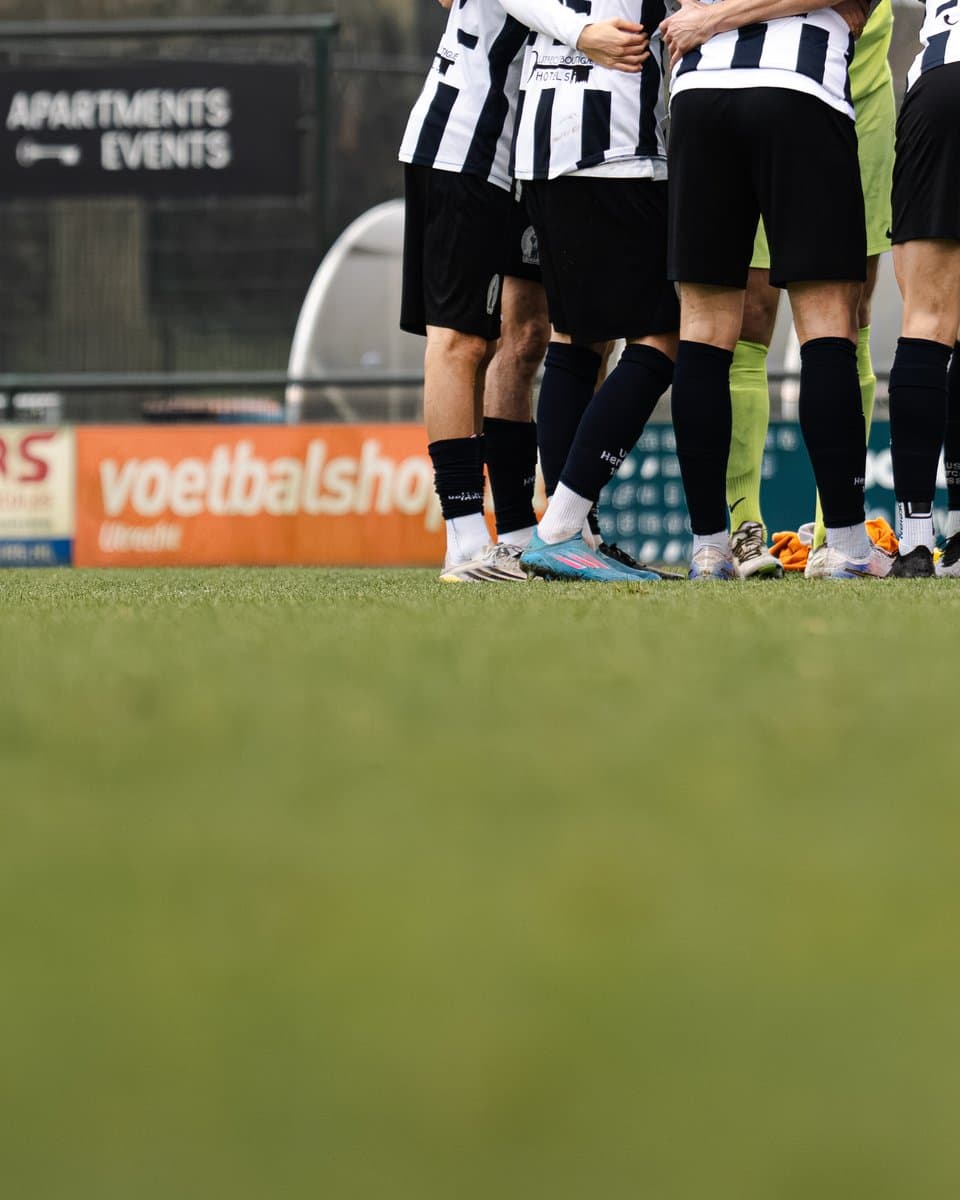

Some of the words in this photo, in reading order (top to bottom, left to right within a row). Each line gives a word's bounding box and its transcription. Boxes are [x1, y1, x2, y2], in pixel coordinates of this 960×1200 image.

[6, 88, 231, 130] APARTMENTS
[101, 130, 231, 170] EVENTS
[0, 431, 56, 483] S
